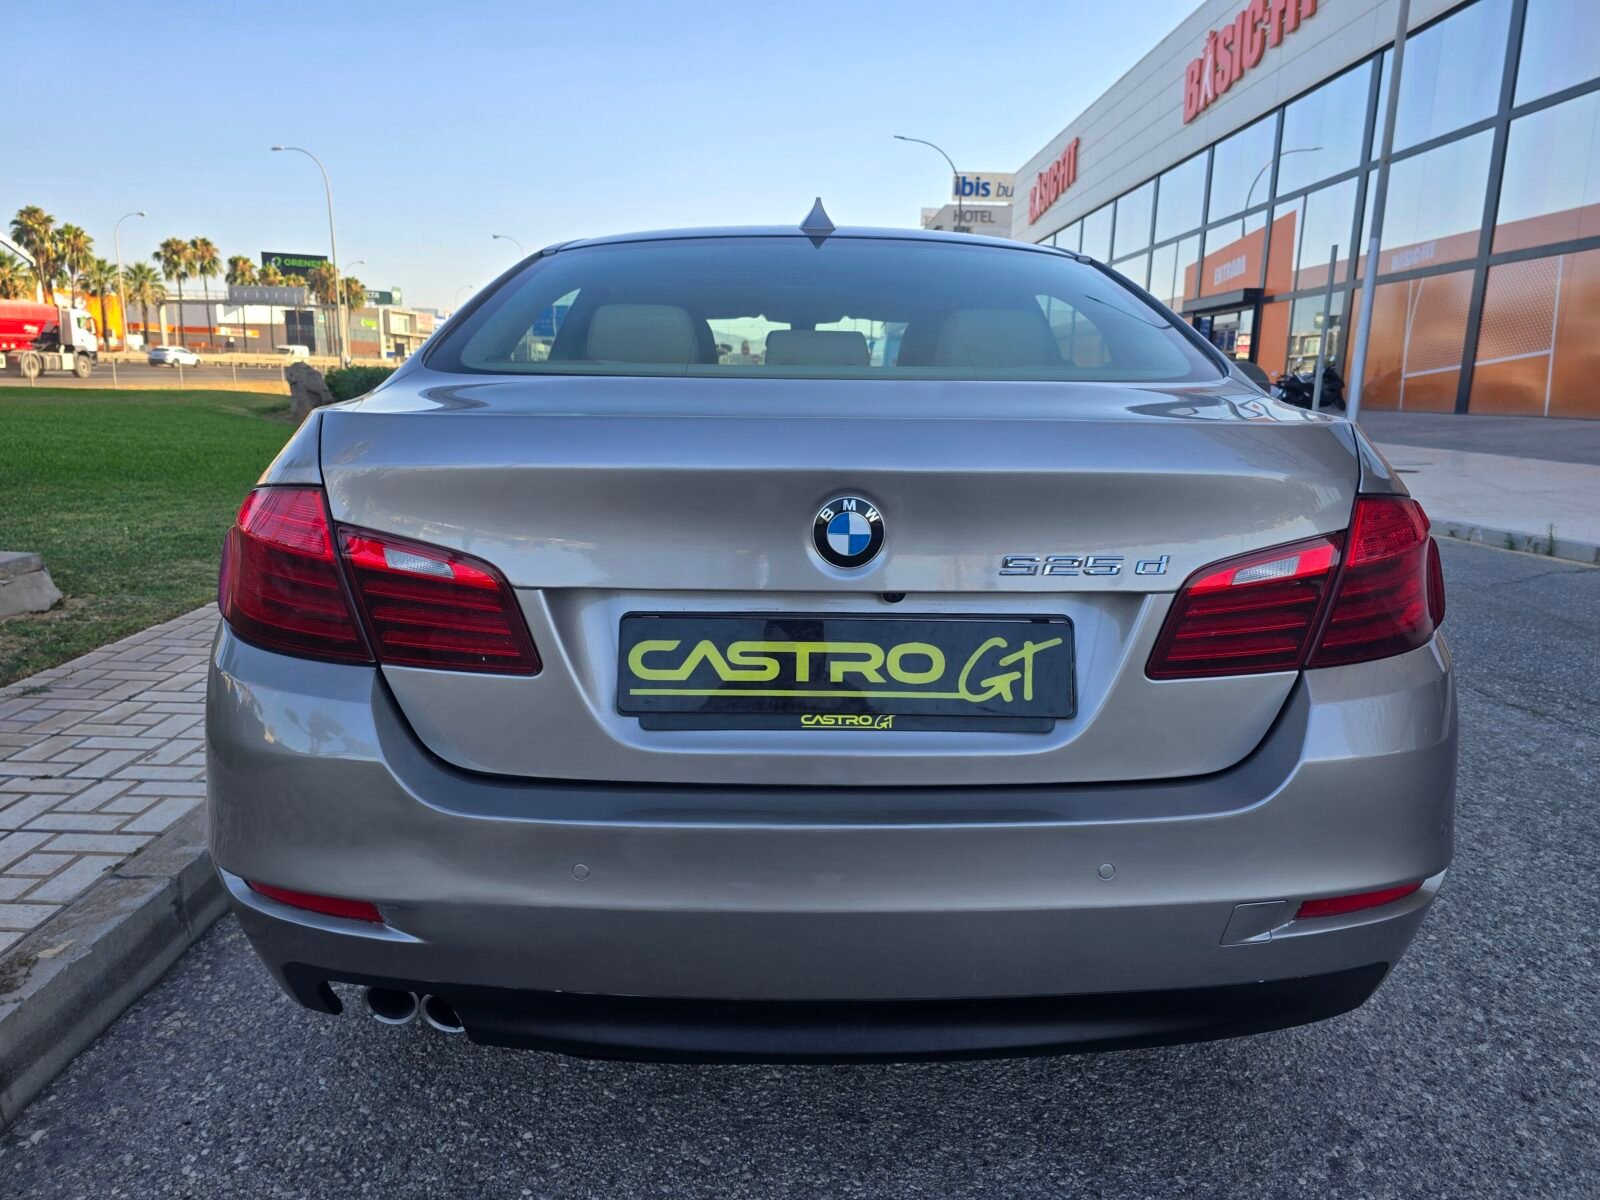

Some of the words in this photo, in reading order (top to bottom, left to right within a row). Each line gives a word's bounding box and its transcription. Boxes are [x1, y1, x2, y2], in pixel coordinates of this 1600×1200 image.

[1183, 0, 1318, 125] BASIC-F
[954, 176, 991, 197] ibis
[953, 210, 996, 223] HOTEL
[820, 499, 880, 523] BMW
[628, 640, 946, 685] CASTRO
[958, 637, 1063, 703] GT
[801, 714, 873, 725] CASTRO
[874, 714, 896, 730] GT
